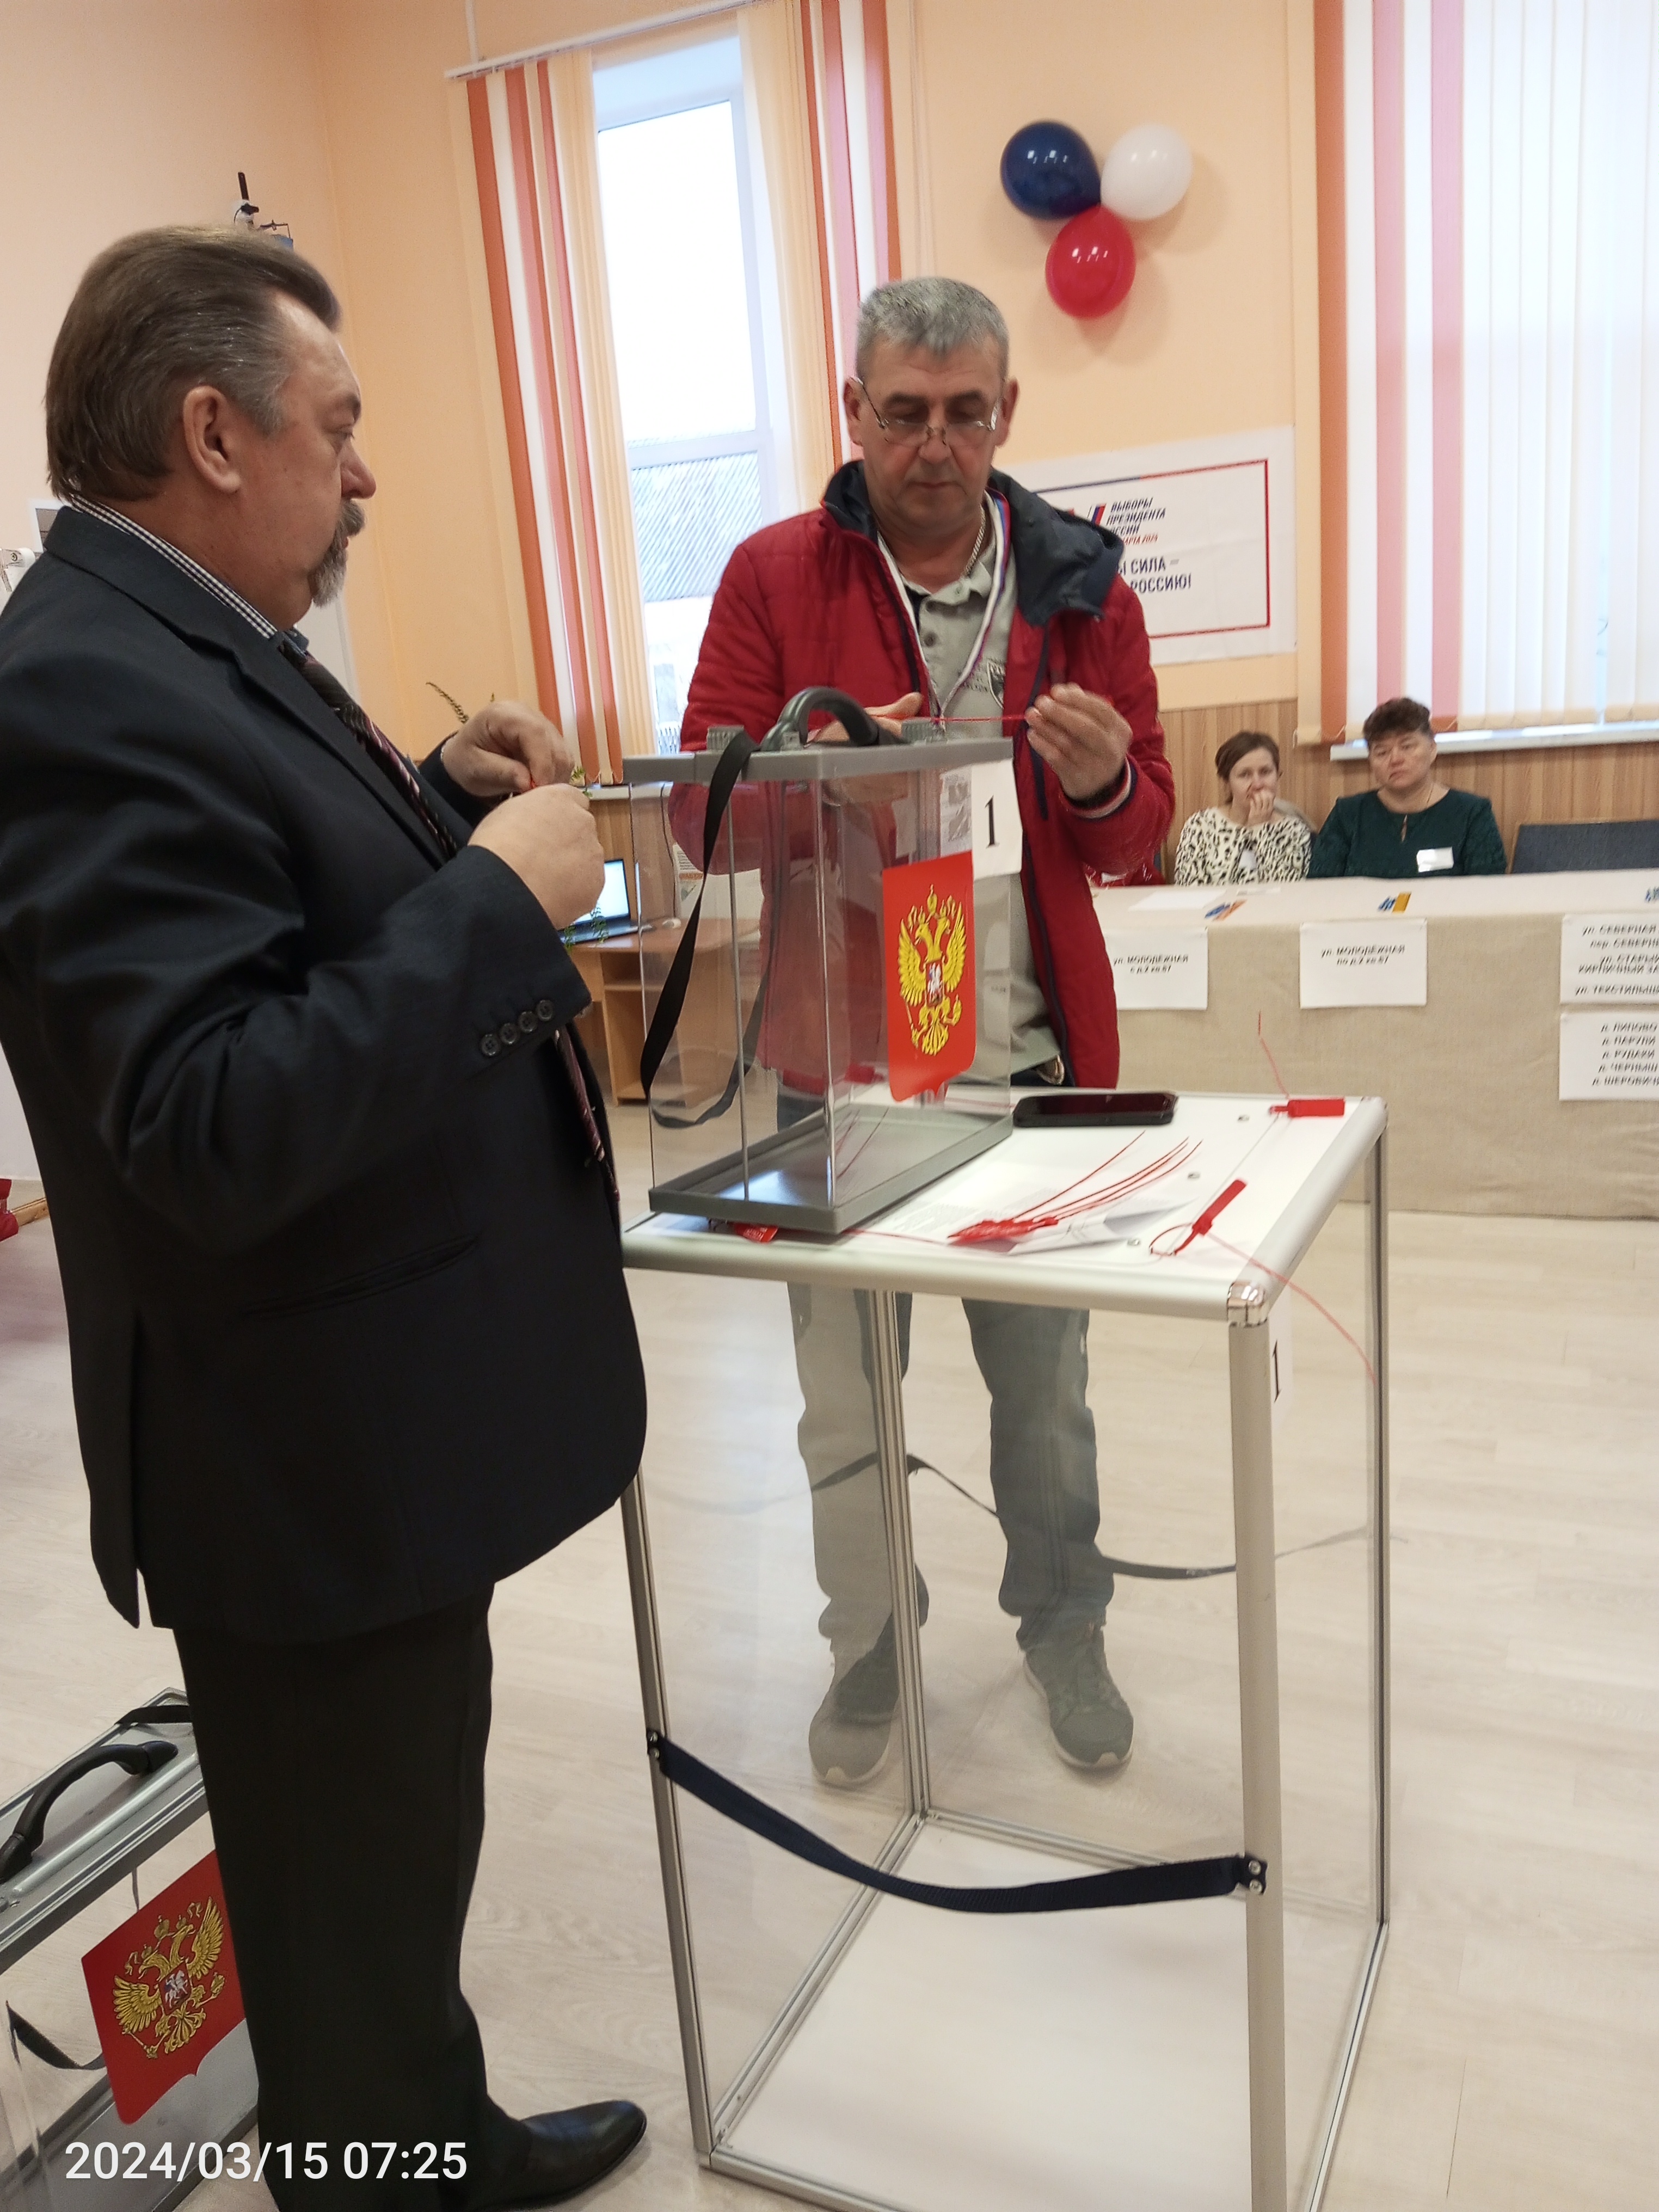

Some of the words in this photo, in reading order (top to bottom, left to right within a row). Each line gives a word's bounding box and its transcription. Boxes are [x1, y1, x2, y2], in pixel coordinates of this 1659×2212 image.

[1111, 496, 1153, 513] ВЫБОРЫ
[1106, 508, 1166, 526] ПРЕЗИДЕНТА
[1111, 523, 1141, 536] ОССИИ
[1123, 535, 1141, 545] АРТА
[1142, 534, 1158, 544] 2024
[1130, 556, 1166, 574] СИЛА
[1130, 573, 1191, 594] РОССИЮ!
[985, 795, 1000, 849] 1
[1600, 925, 1657, 935] СЕВЕРНАЯ
[1272, 1340, 1282, 1403] 1
